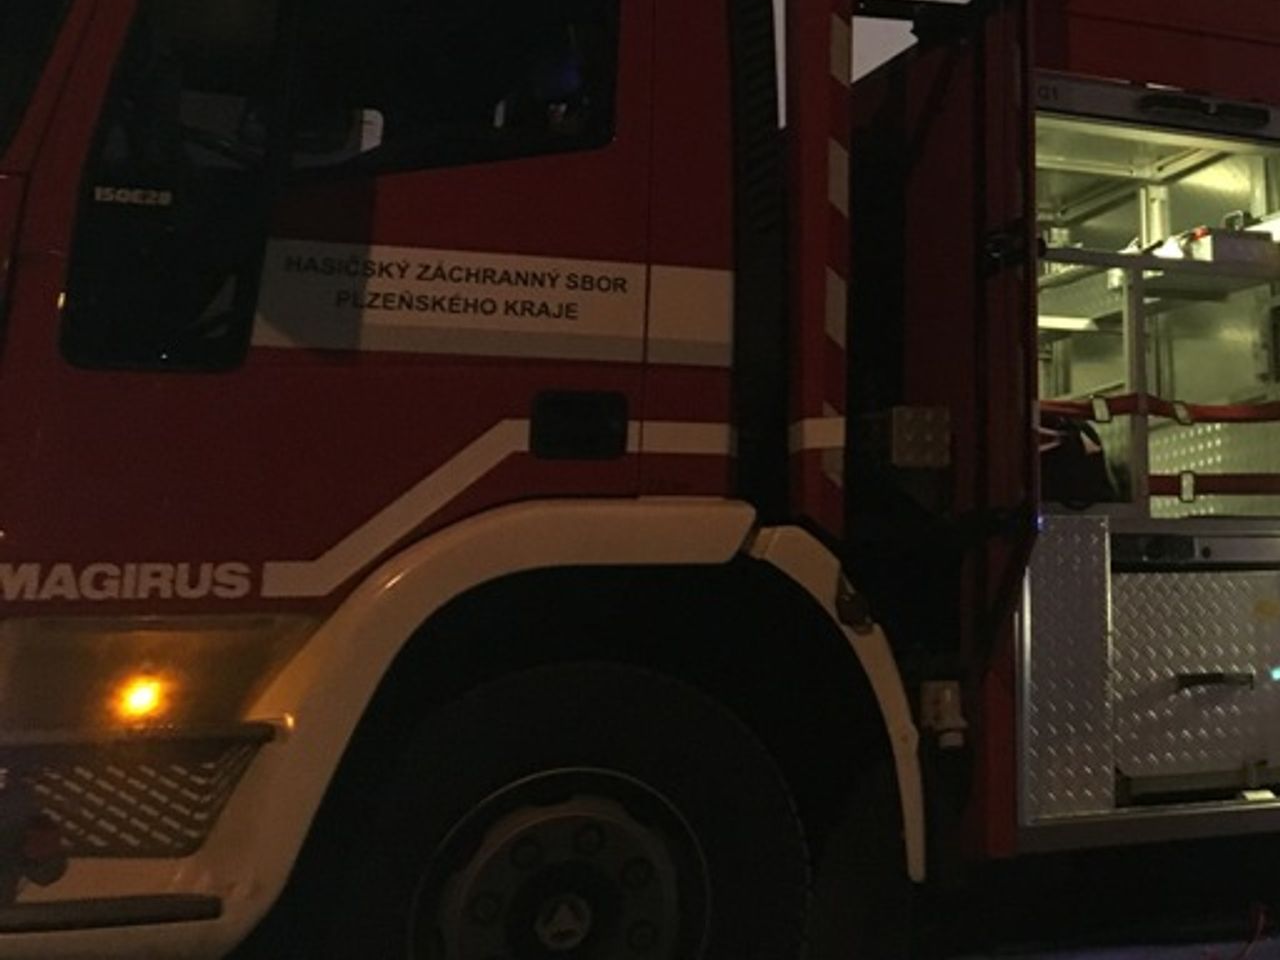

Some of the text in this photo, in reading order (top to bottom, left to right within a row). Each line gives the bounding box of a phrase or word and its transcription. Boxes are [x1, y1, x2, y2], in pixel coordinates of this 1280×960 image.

[285, 253, 628, 294] HASIČSKÝ ZÁCHRANNÝ SBOR
[336, 288, 579, 320] PLZEŇSKÉHO KRAJE
[0, 561, 251, 600] MAGIRUS
